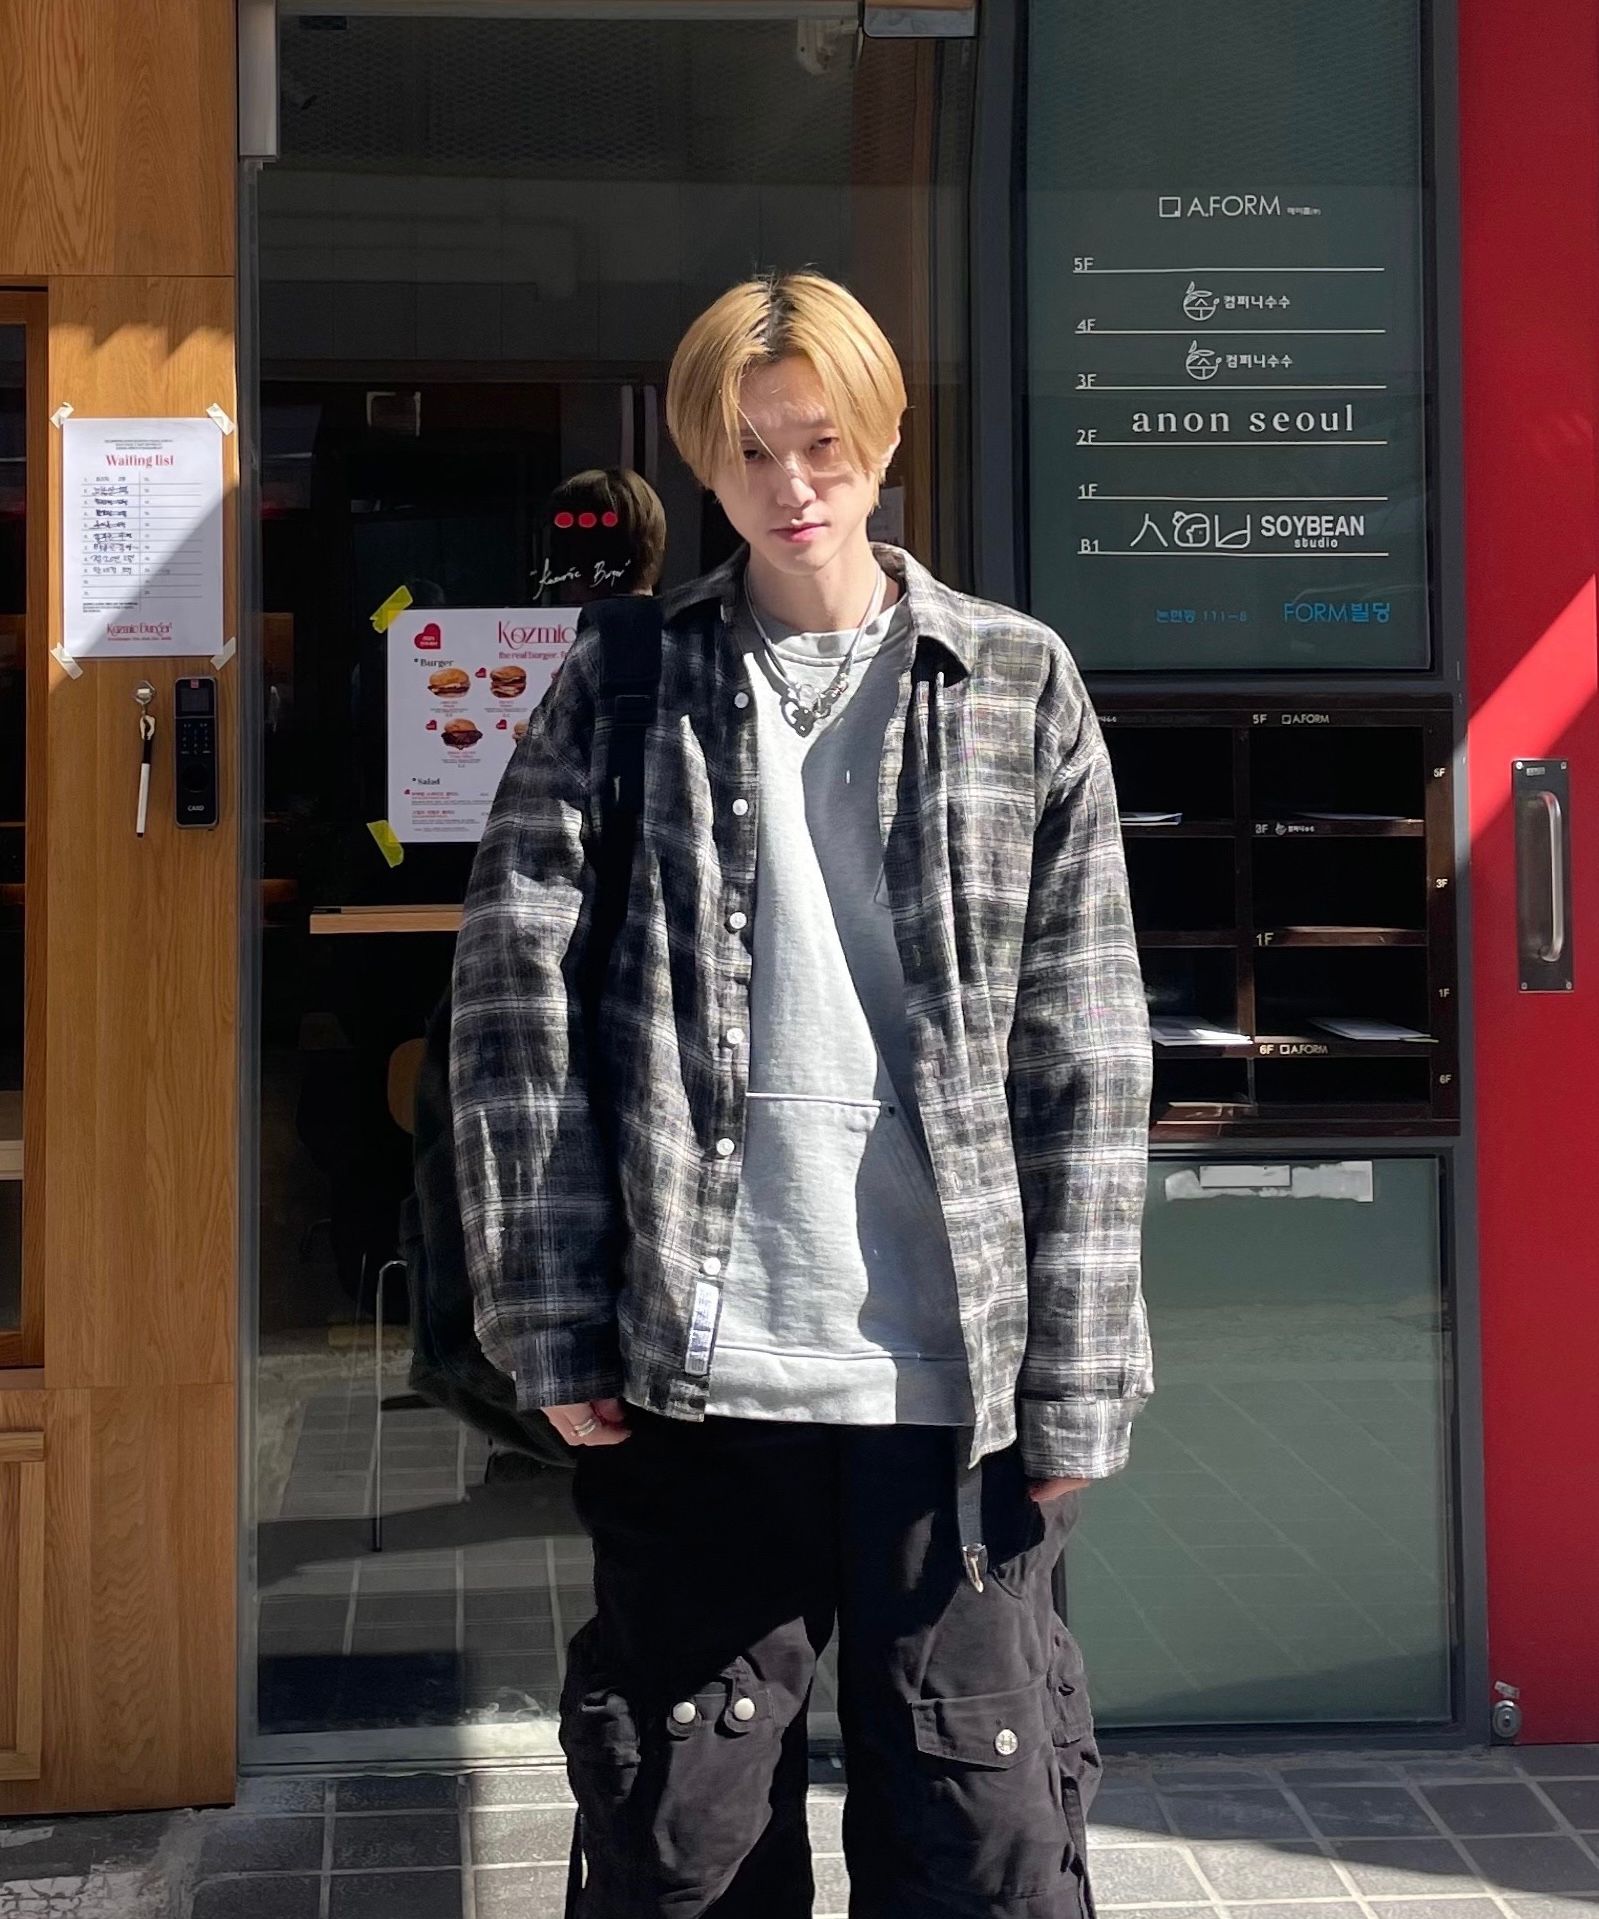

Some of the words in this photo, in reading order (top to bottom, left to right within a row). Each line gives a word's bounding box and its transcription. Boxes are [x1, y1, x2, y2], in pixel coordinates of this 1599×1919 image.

[1073, 257, 1094, 271] 5F
[1223, 295, 1291, 310] 컴퍼니수수
[1076, 318, 1097, 332] 4F
[1226, 354, 1293, 369] 컴퍼니수수
[1077, 373, 1097, 388] 3F
[1132, 411, 1231, 433] anon
[1249, 404, 1353, 433] seoul
[1076, 429, 1097, 443] 2F
[105, 454, 153, 468] Waiting
[155, 454, 174, 466] list
[1078, 483, 1098, 498] 1F
[1260, 515, 1365, 537] SOYBEAN
[1080, 538, 1100, 553] B1
[1294, 537, 1339, 549] studio
[1283, 602, 1390, 624] FORM빌딩
[420, 659, 454, 668] Burger
[1252, 714, 1268, 725] 5F
[1435, 878, 1448, 889] 3F
[1256, 932, 1274, 947] 1F
[1438, 988, 1450, 998] 1F
[1259, 1044, 1275, 1055] 6F
